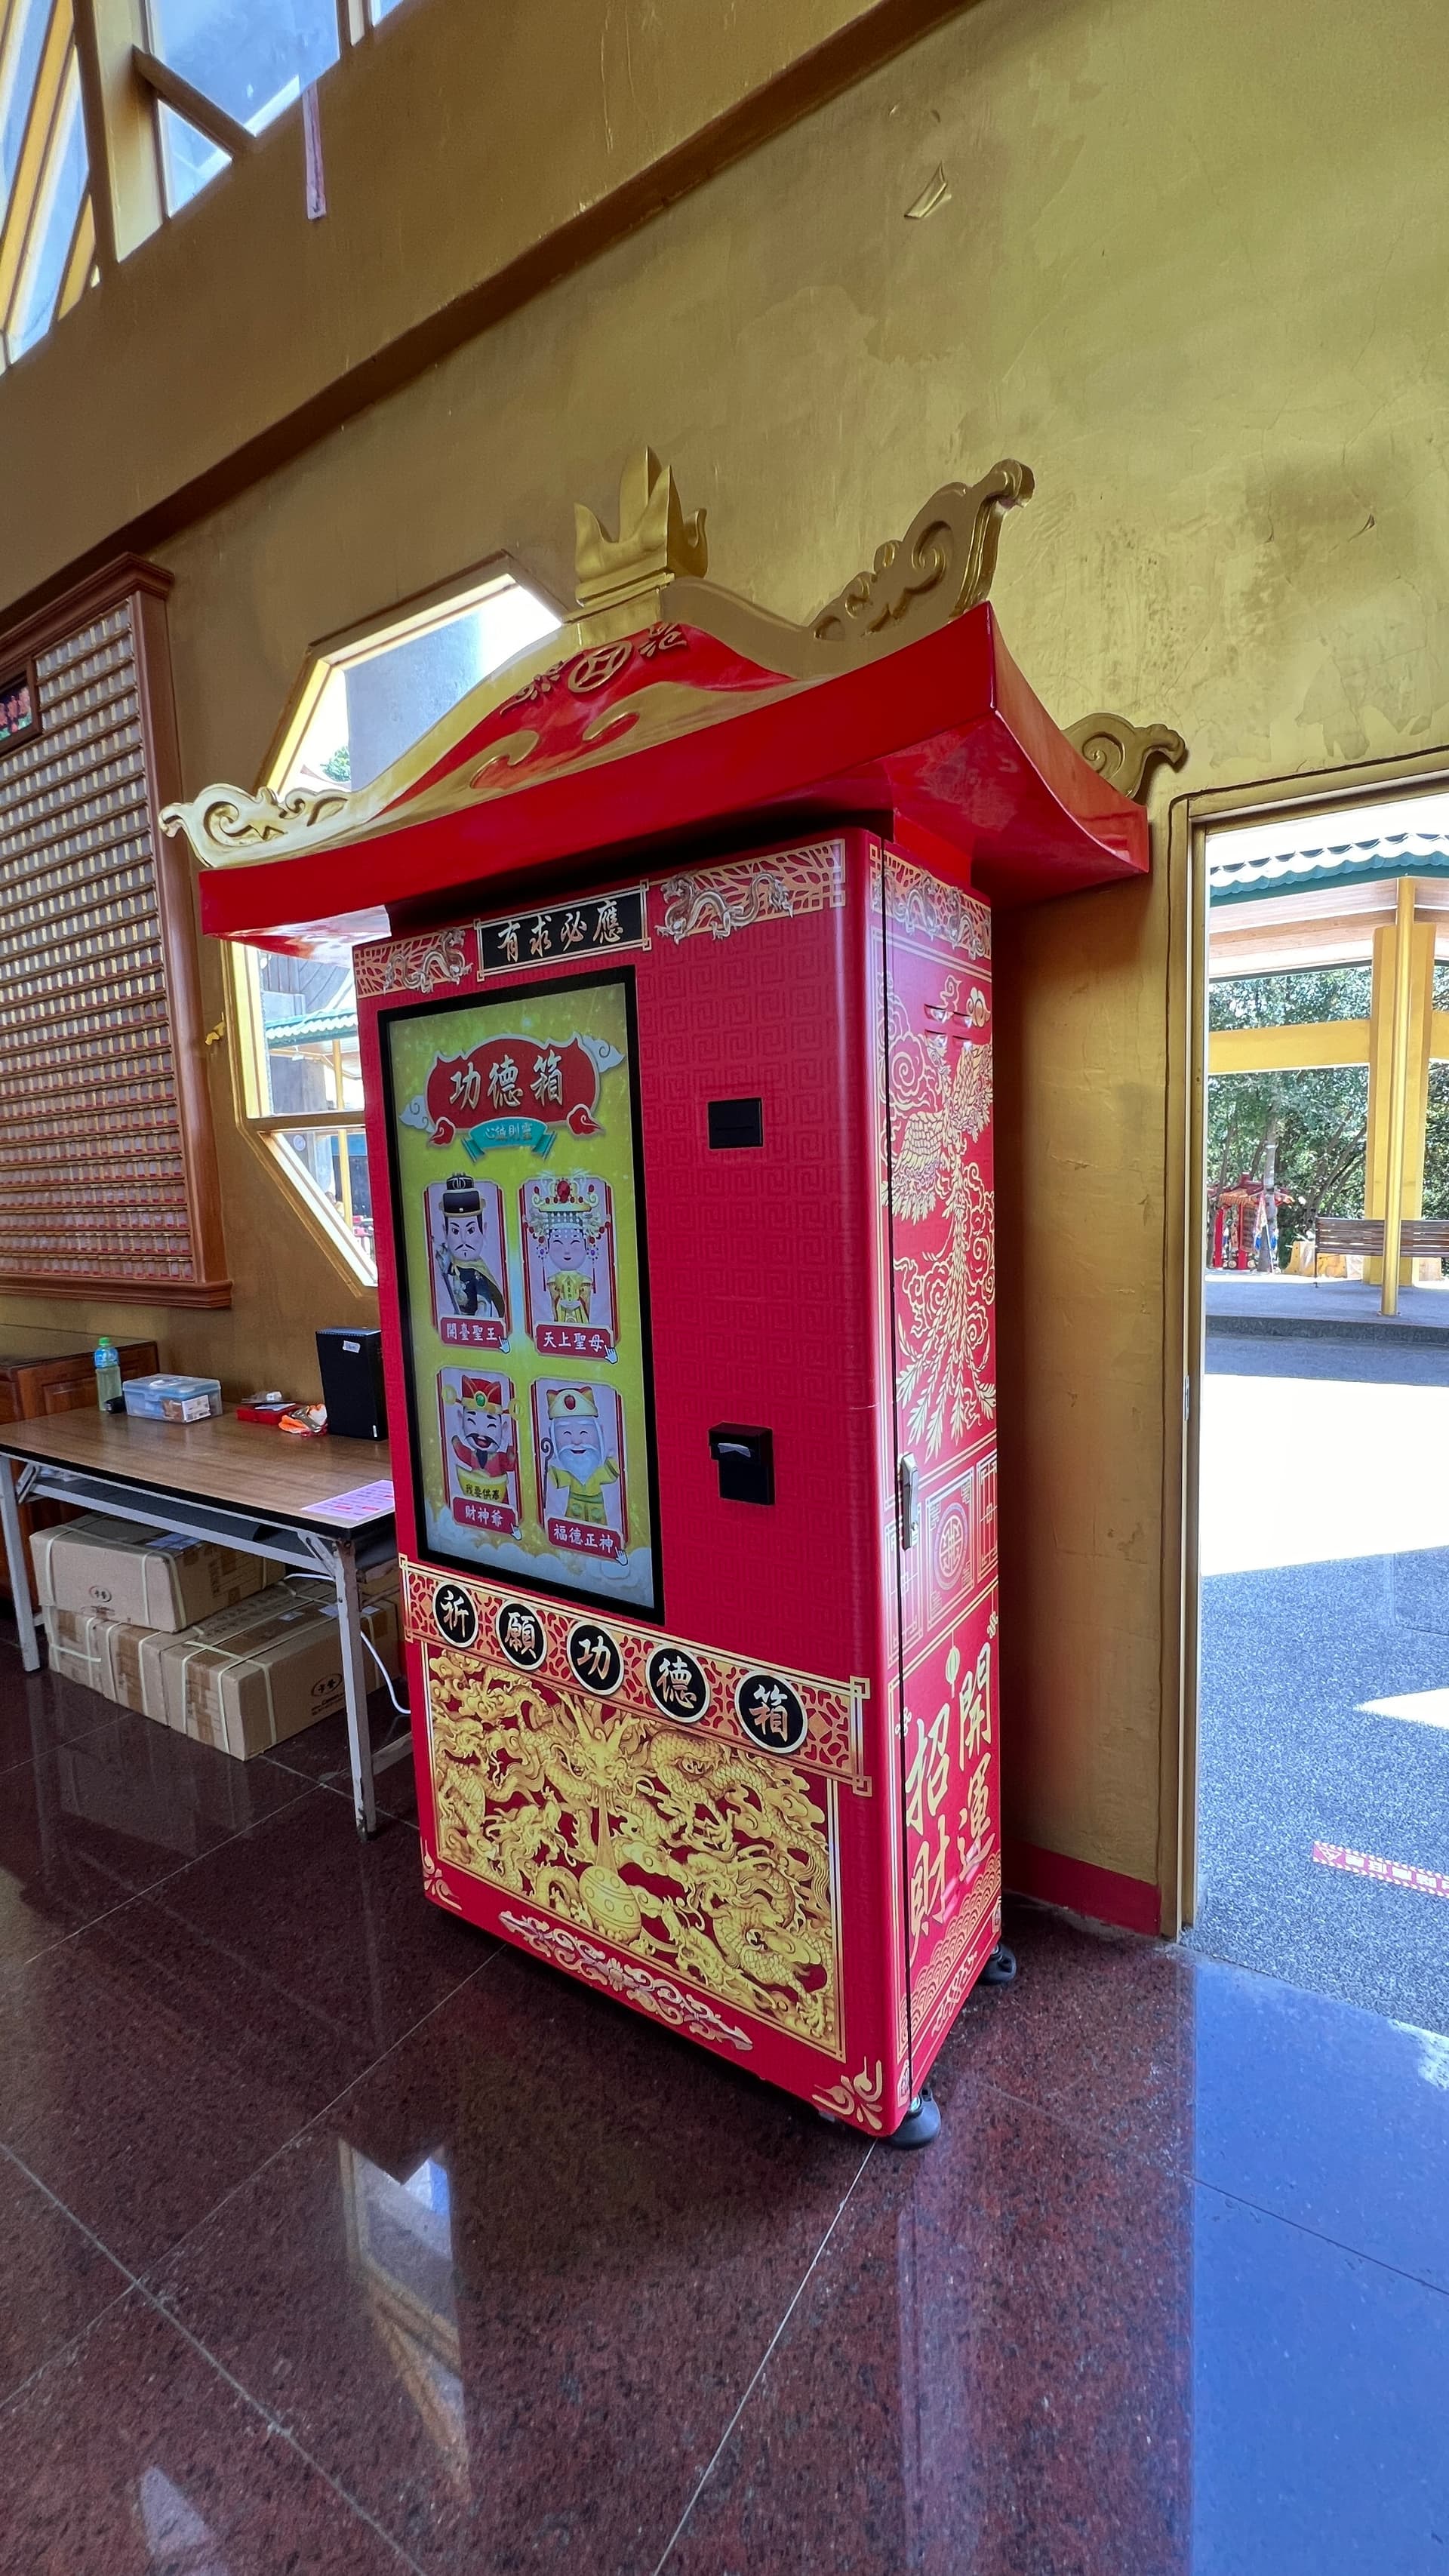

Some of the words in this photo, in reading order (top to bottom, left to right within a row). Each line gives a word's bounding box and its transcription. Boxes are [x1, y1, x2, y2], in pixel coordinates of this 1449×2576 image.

[497, 901, 624, 962] 有求必應
[450, 1050, 563, 1109] 功德箱
[446, 1322, 497, 1341] 開臺聖王
[543, 1331, 605, 1353] 天上聖母
[465, 1505, 503, 1528] 財神爺
[553, 1524, 614, 1554] 福德正神
[440, 1589, 788, 1743] 祈願功德箱
[958, 1642, 996, 1882] 開運
[906, 1702, 950, 1968] 招財
